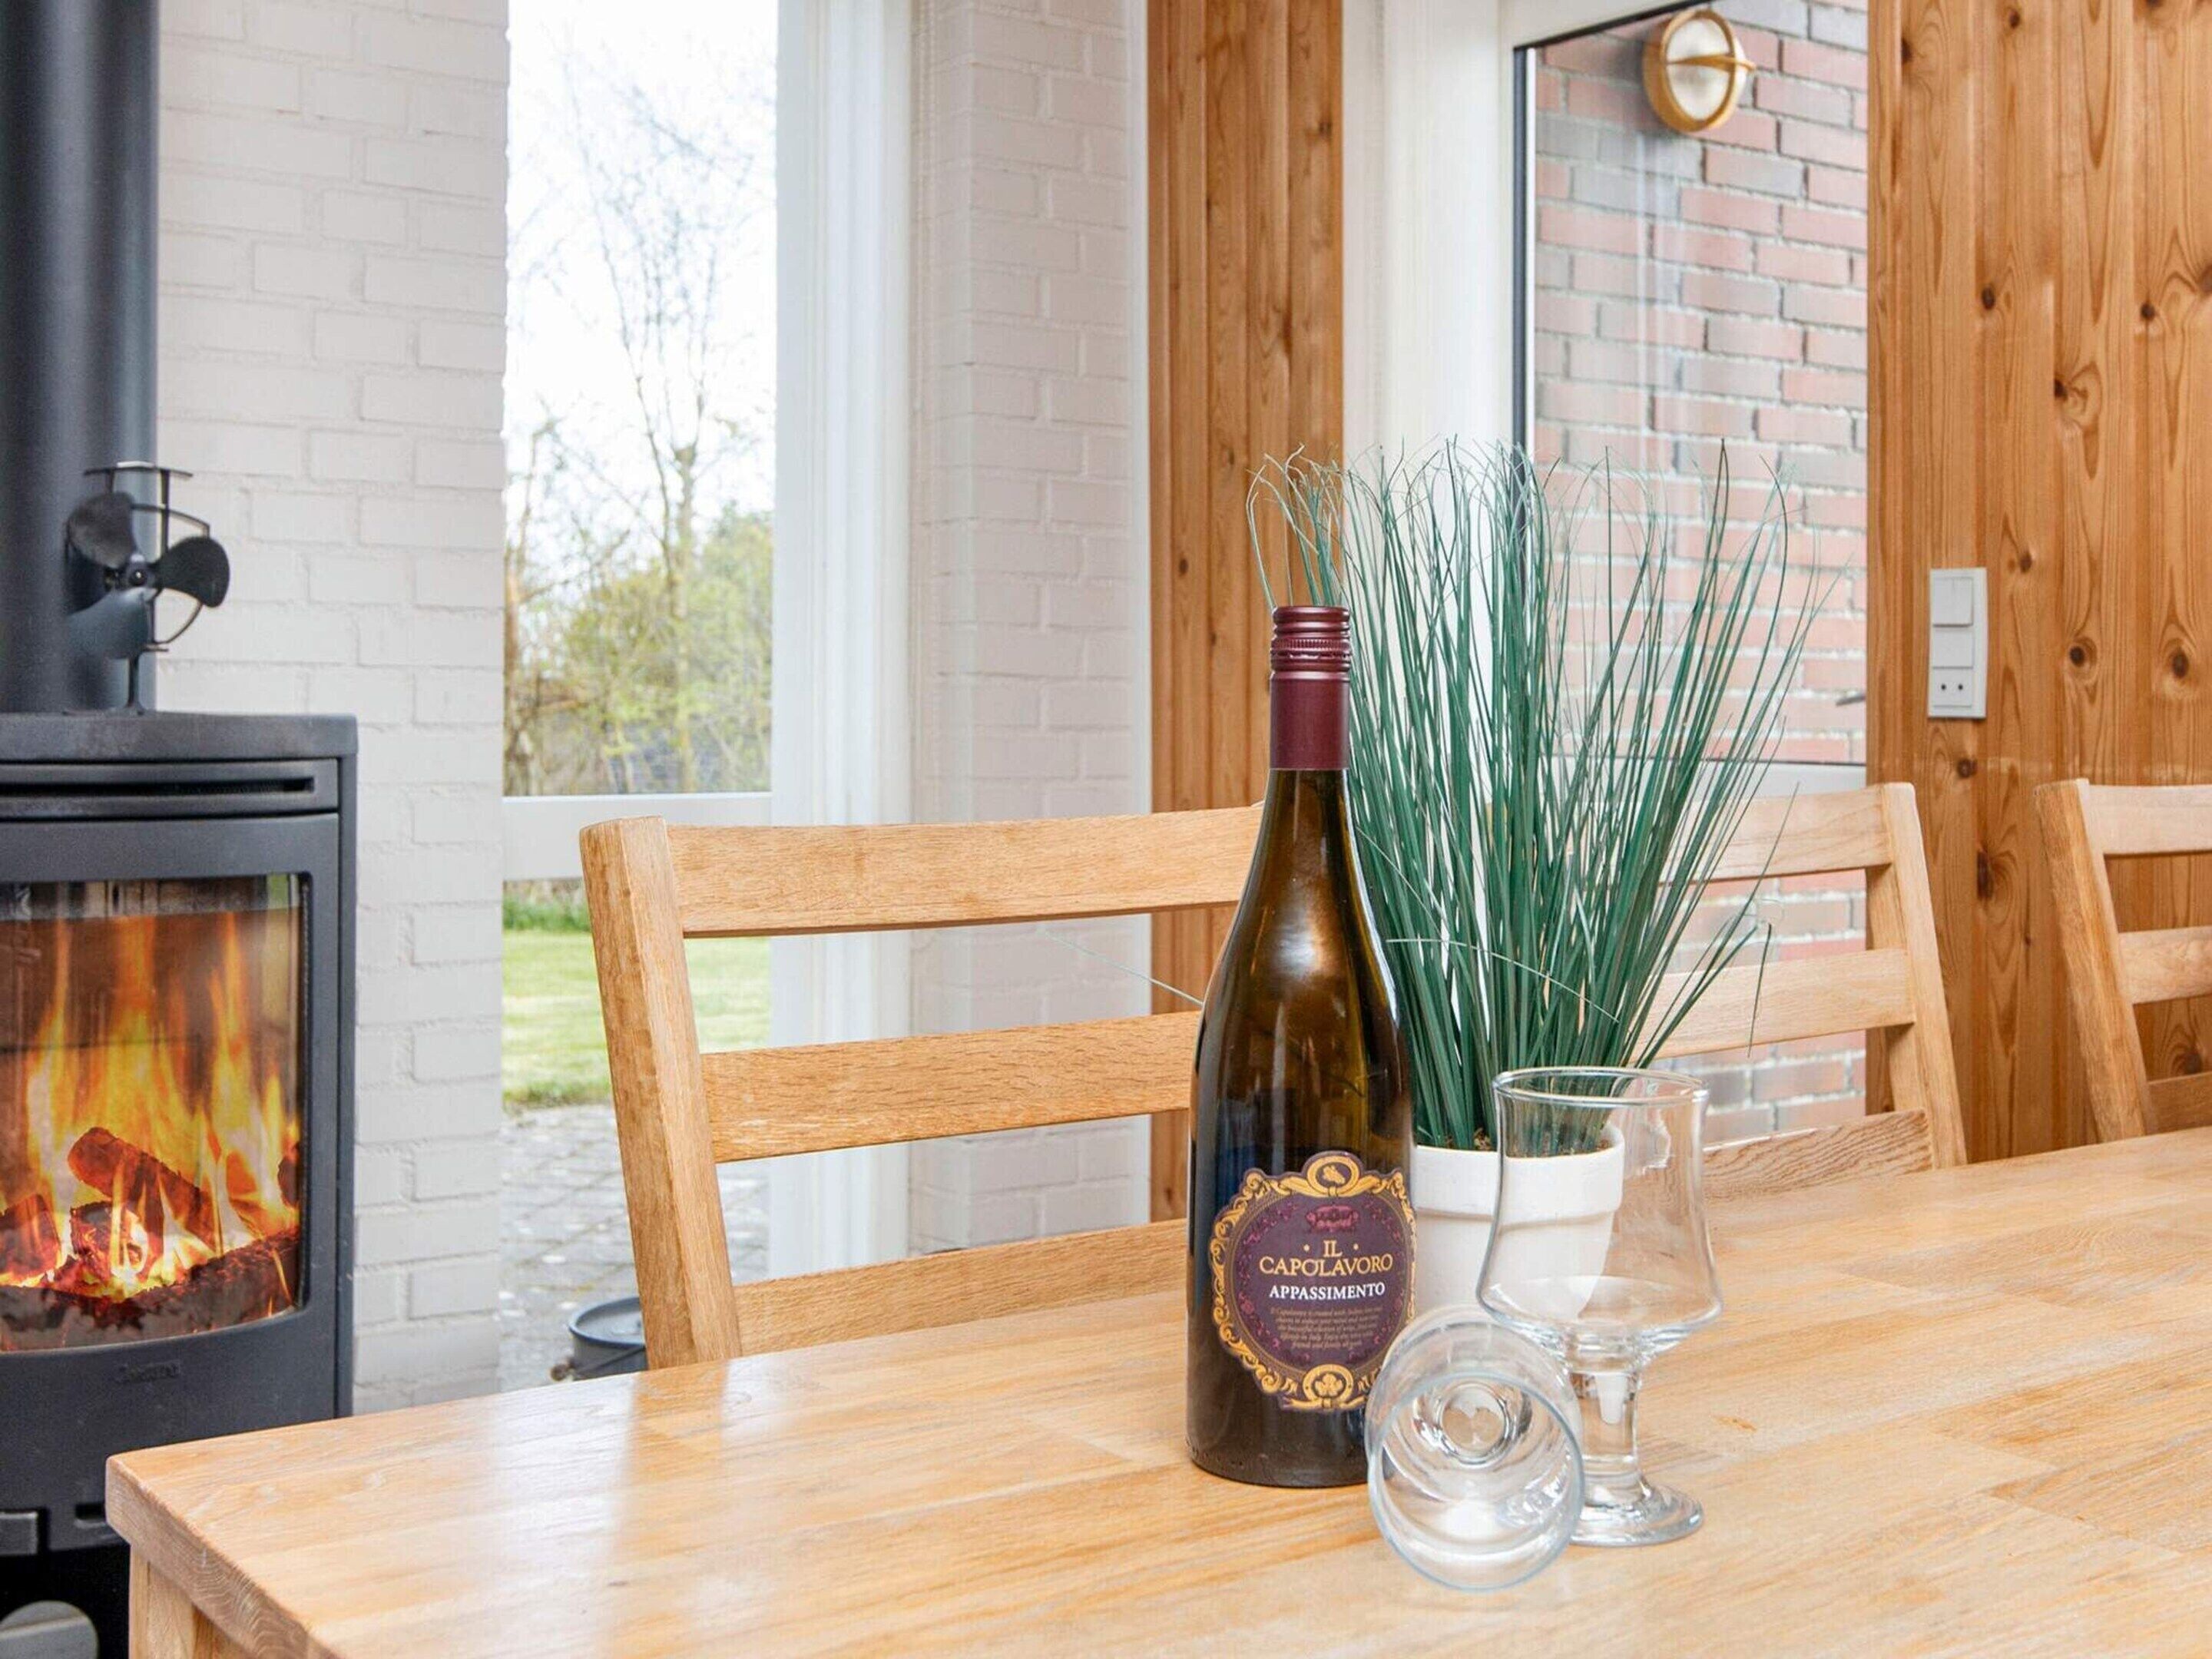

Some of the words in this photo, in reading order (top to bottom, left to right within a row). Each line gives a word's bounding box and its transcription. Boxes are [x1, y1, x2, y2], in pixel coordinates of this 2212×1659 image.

[1323, 1240, 1343, 1257] IL
[1259, 1254, 1393, 1277] CAPOLAVORO
[1270, 1283, 1385, 1300] APPASSIMENTO
